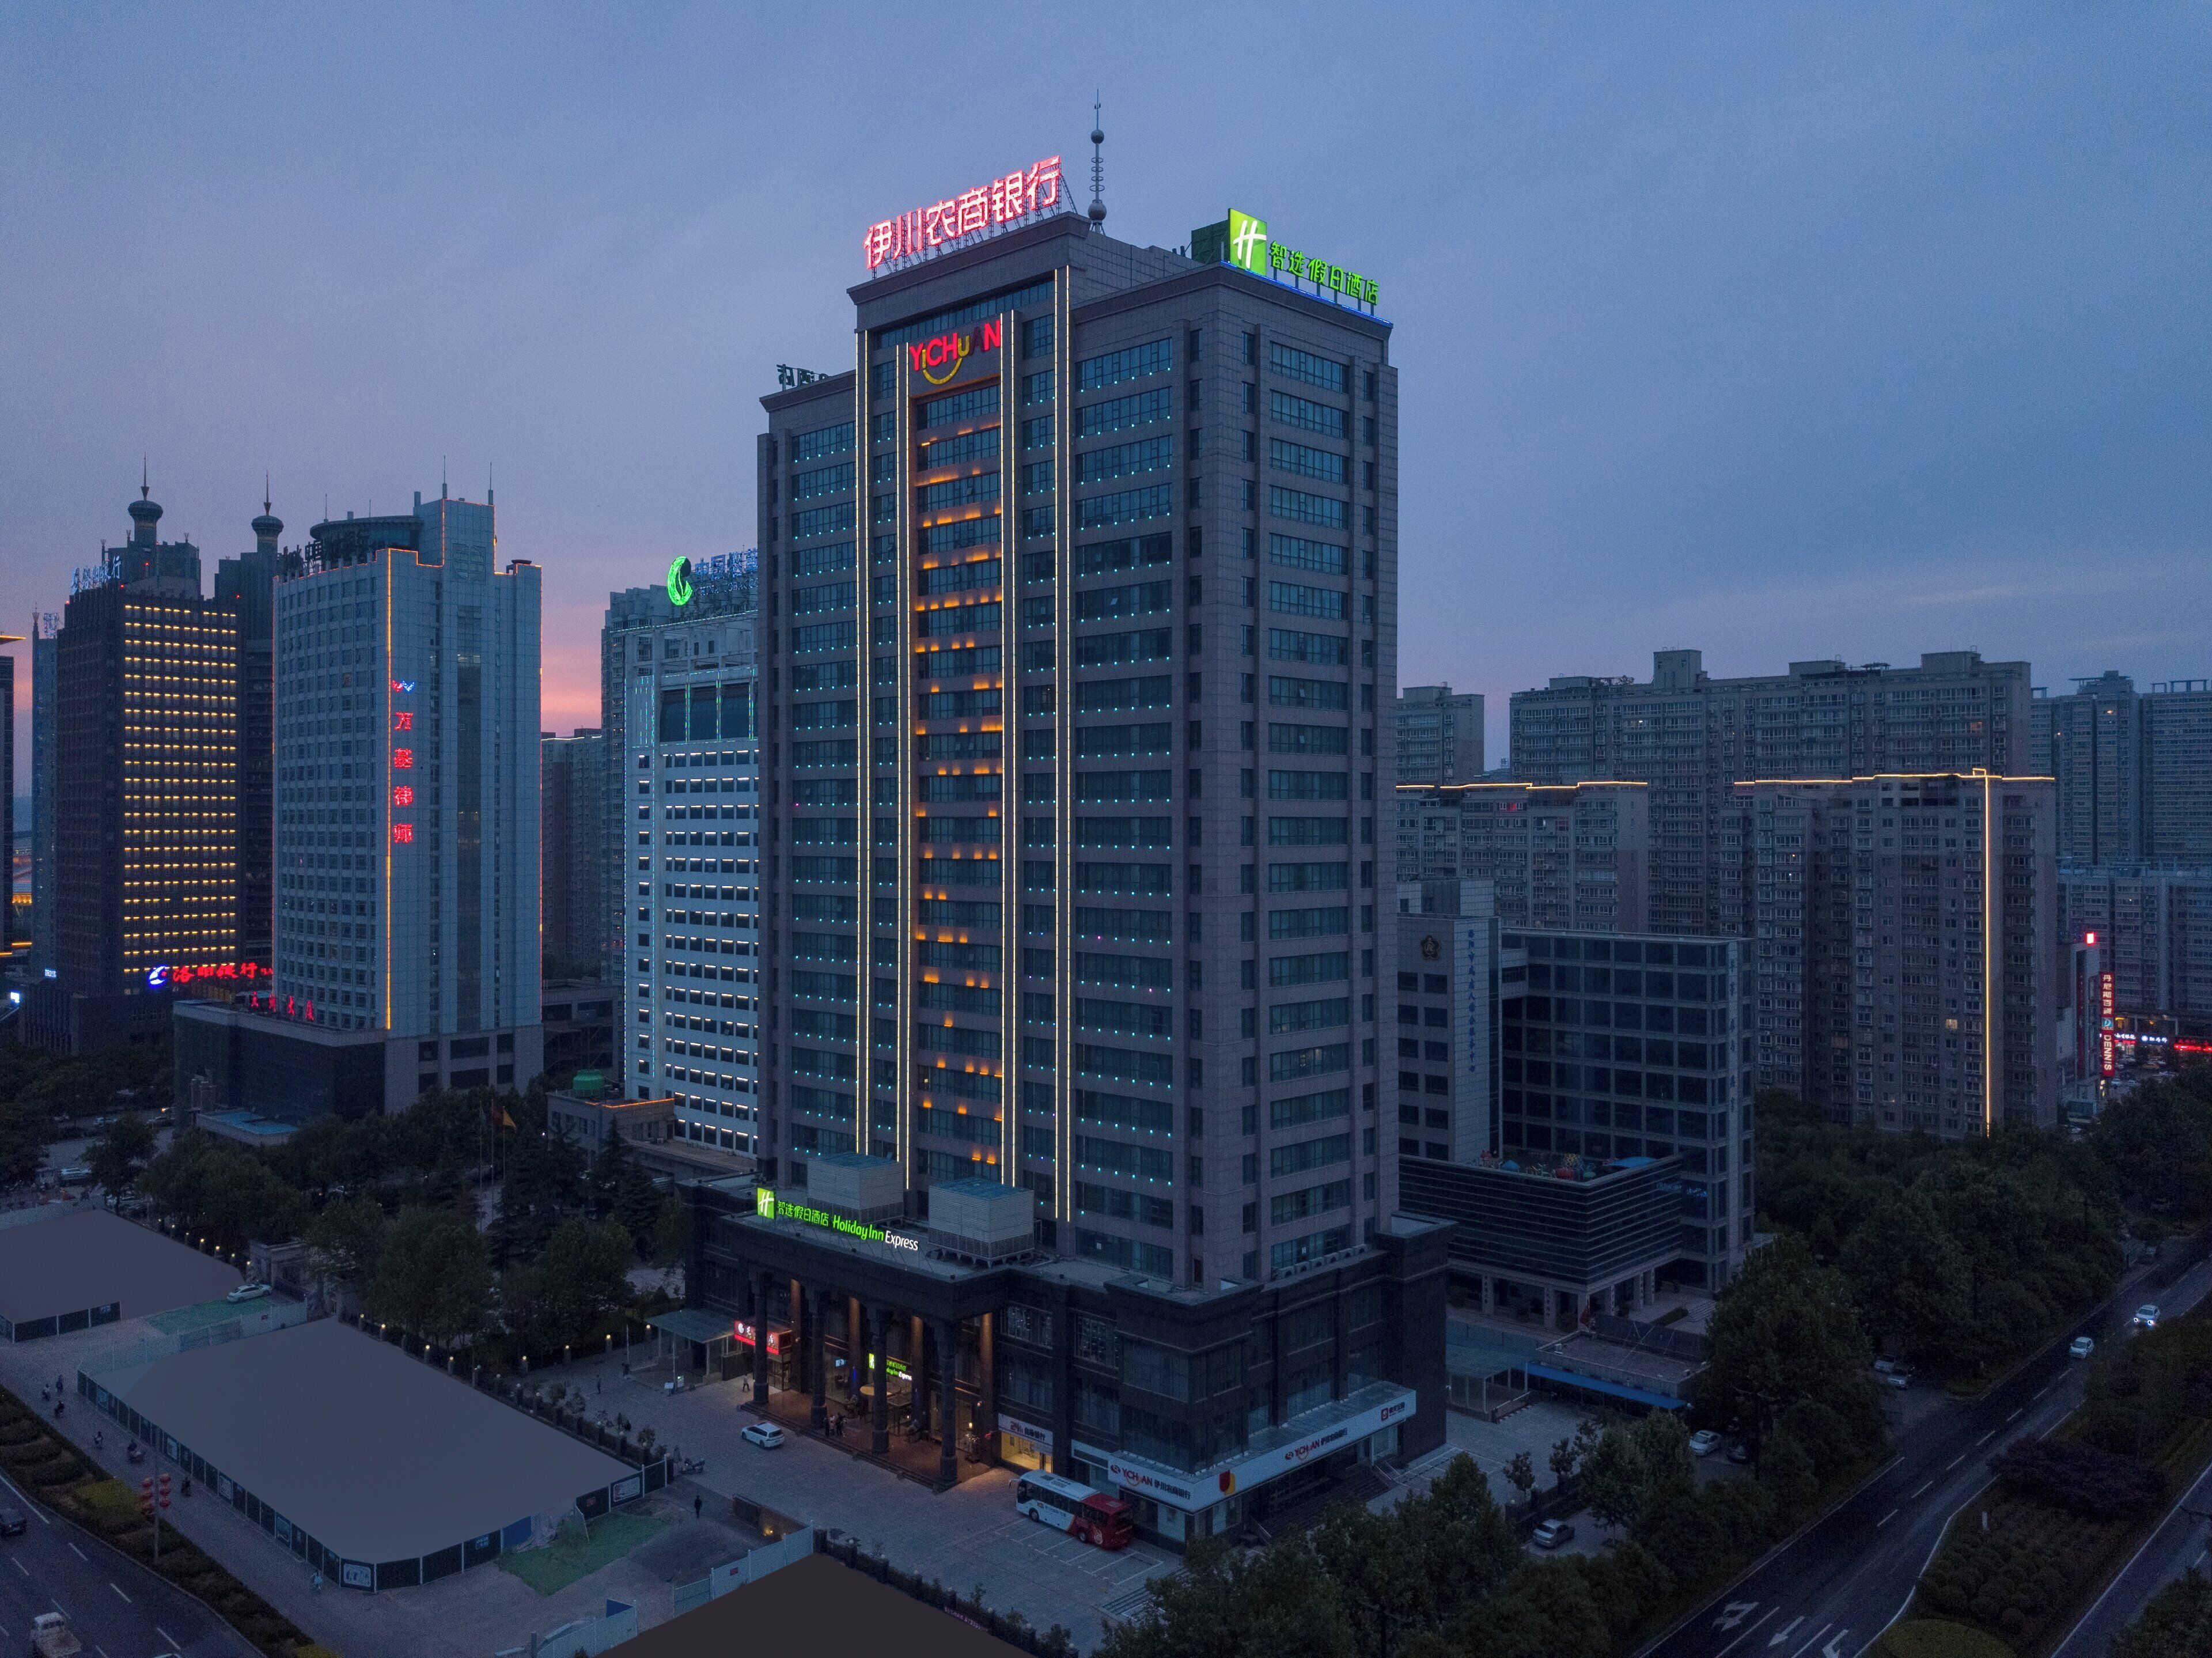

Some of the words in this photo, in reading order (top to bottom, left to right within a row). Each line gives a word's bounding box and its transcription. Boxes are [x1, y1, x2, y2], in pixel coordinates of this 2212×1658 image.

[863, 155, 1060, 270] 伊川农商银行
[1269, 240, 1380, 305] 智选假日酒店
[393, 711, 413, 843] 万基律师
[172, 962, 257, 983] 洛阳银行
[2104, 1035, 2112, 1071] DENNIS
[777, 1200, 830, 1227] 智选假日酒店
[832, 1215, 868, 1240] Holiday
[869, 1224, 884, 1241] Inn
[885, 1230, 918, 1251] Express
